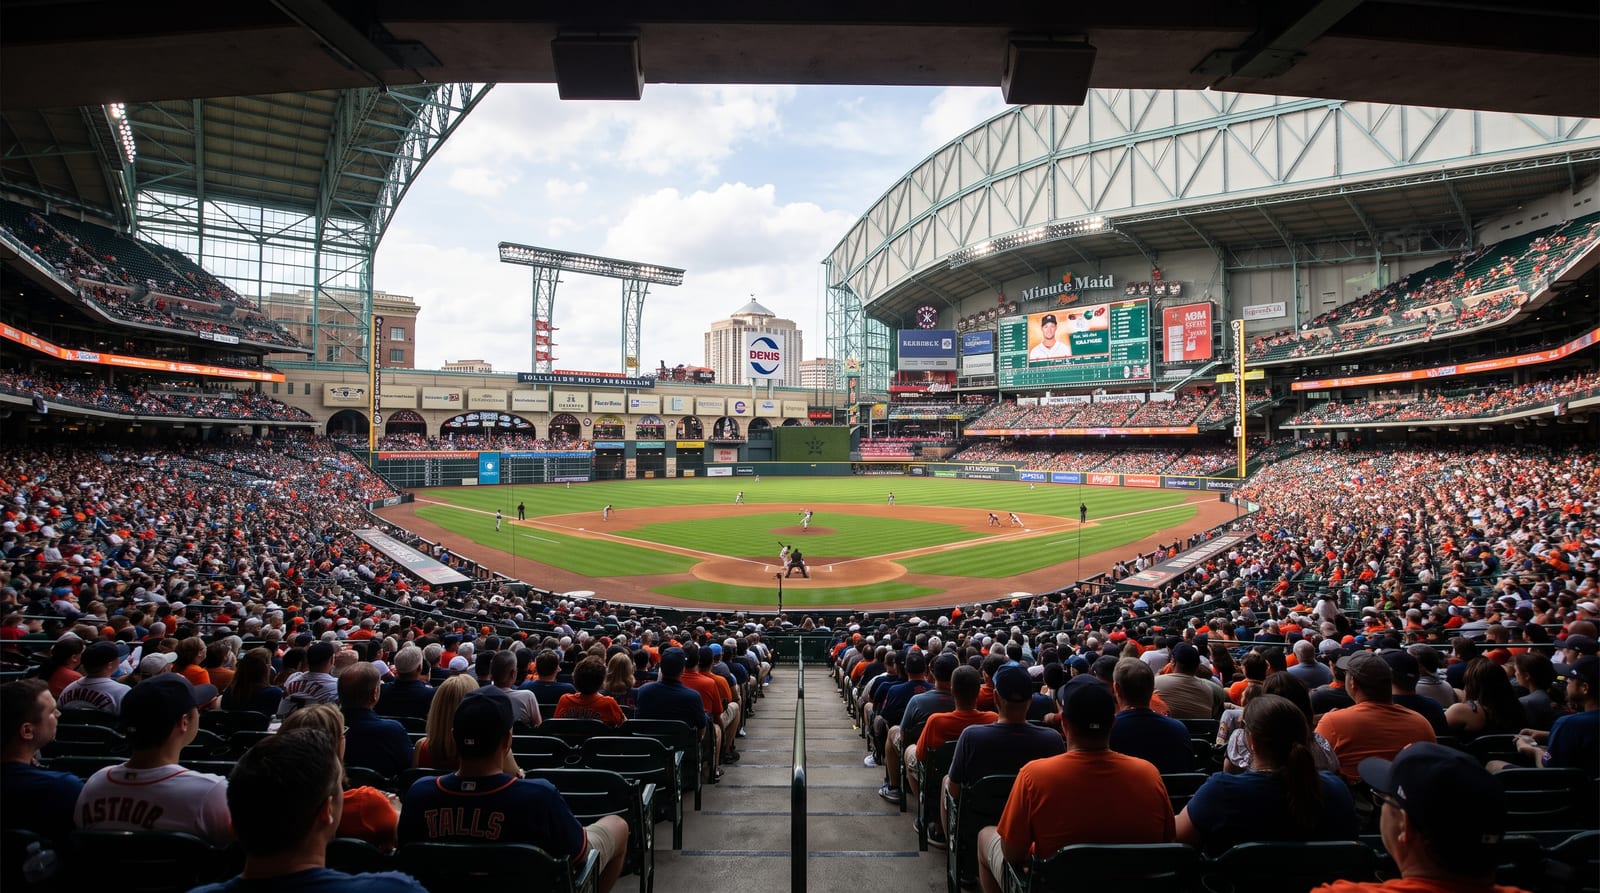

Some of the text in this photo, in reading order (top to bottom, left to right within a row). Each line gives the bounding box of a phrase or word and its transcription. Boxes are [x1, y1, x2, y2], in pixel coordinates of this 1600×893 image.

[1021, 281, 1072, 302] Minute
[1074, 274, 1114, 290] Maid
[750, 350, 780, 361] DENIS
[424, 806, 506, 840] TALLS
